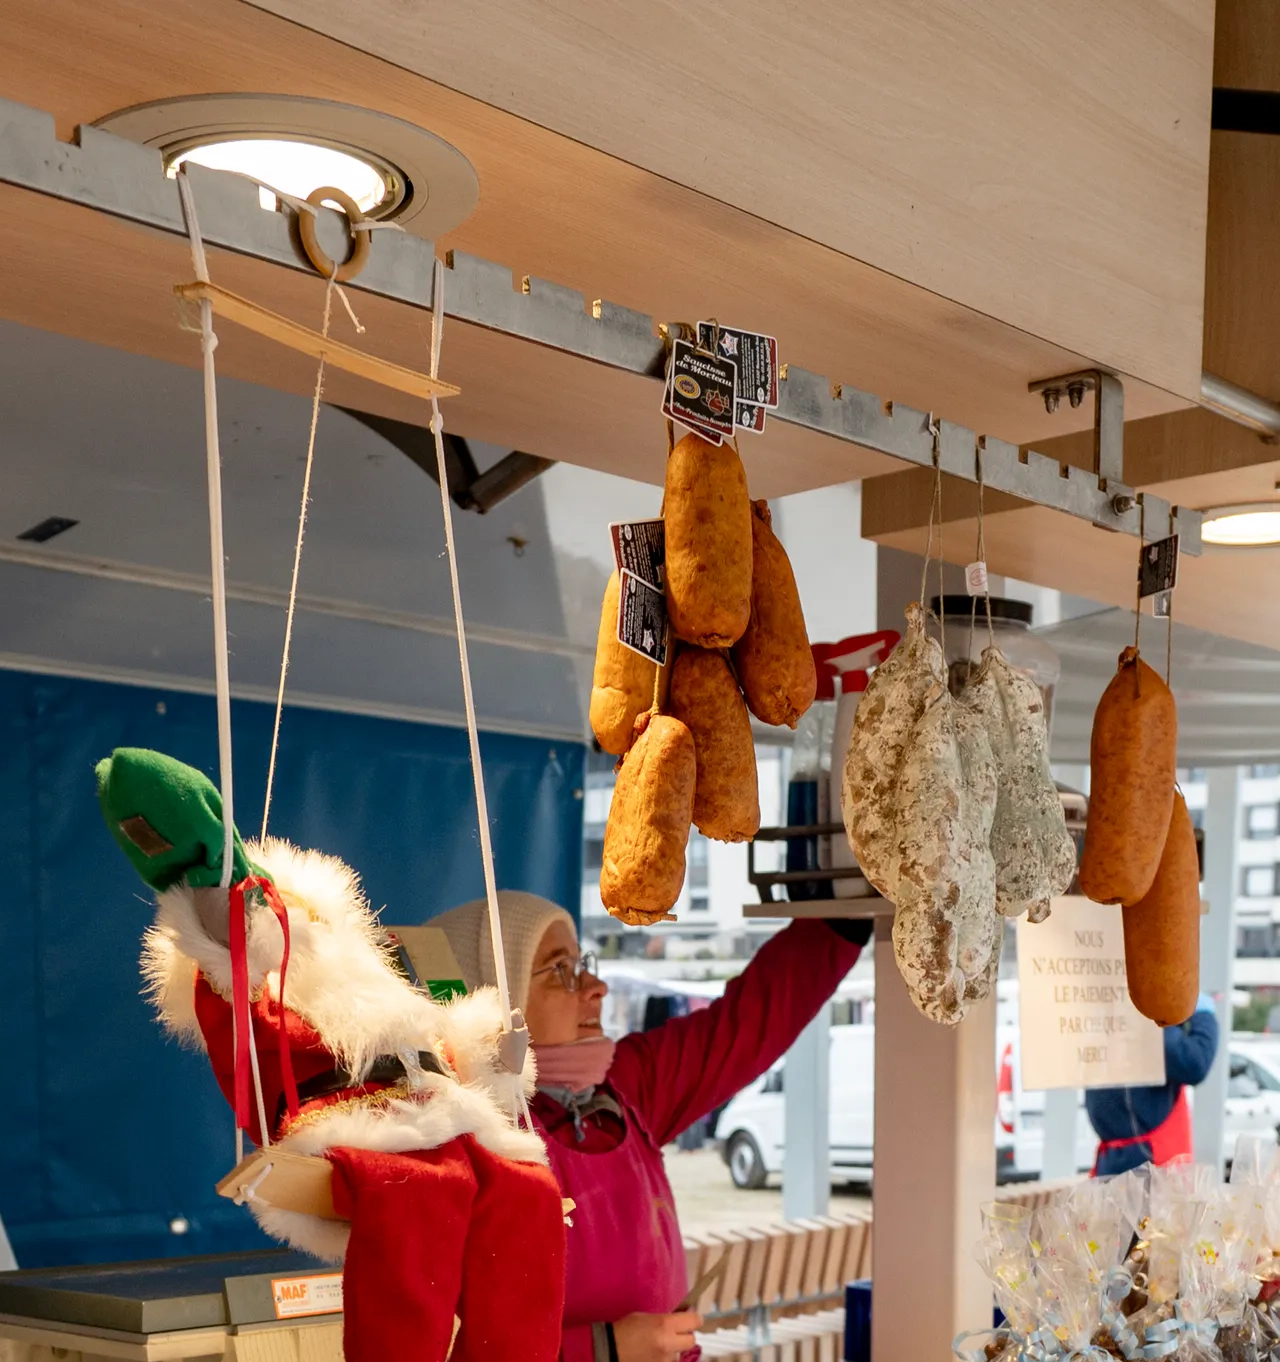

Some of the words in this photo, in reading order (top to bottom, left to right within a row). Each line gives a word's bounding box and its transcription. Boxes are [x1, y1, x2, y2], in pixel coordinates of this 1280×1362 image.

[676, 359, 689, 369] de
[690, 364, 733, 388] Morteau
[683, 354, 726, 378] Saucisse
[1074, 930, 1104, 948] NOUS
[1054, 985, 1070, 1003] LE
[1059, 1016, 1084, 1034] PAR
[281, 1283, 308, 1301] MAF
